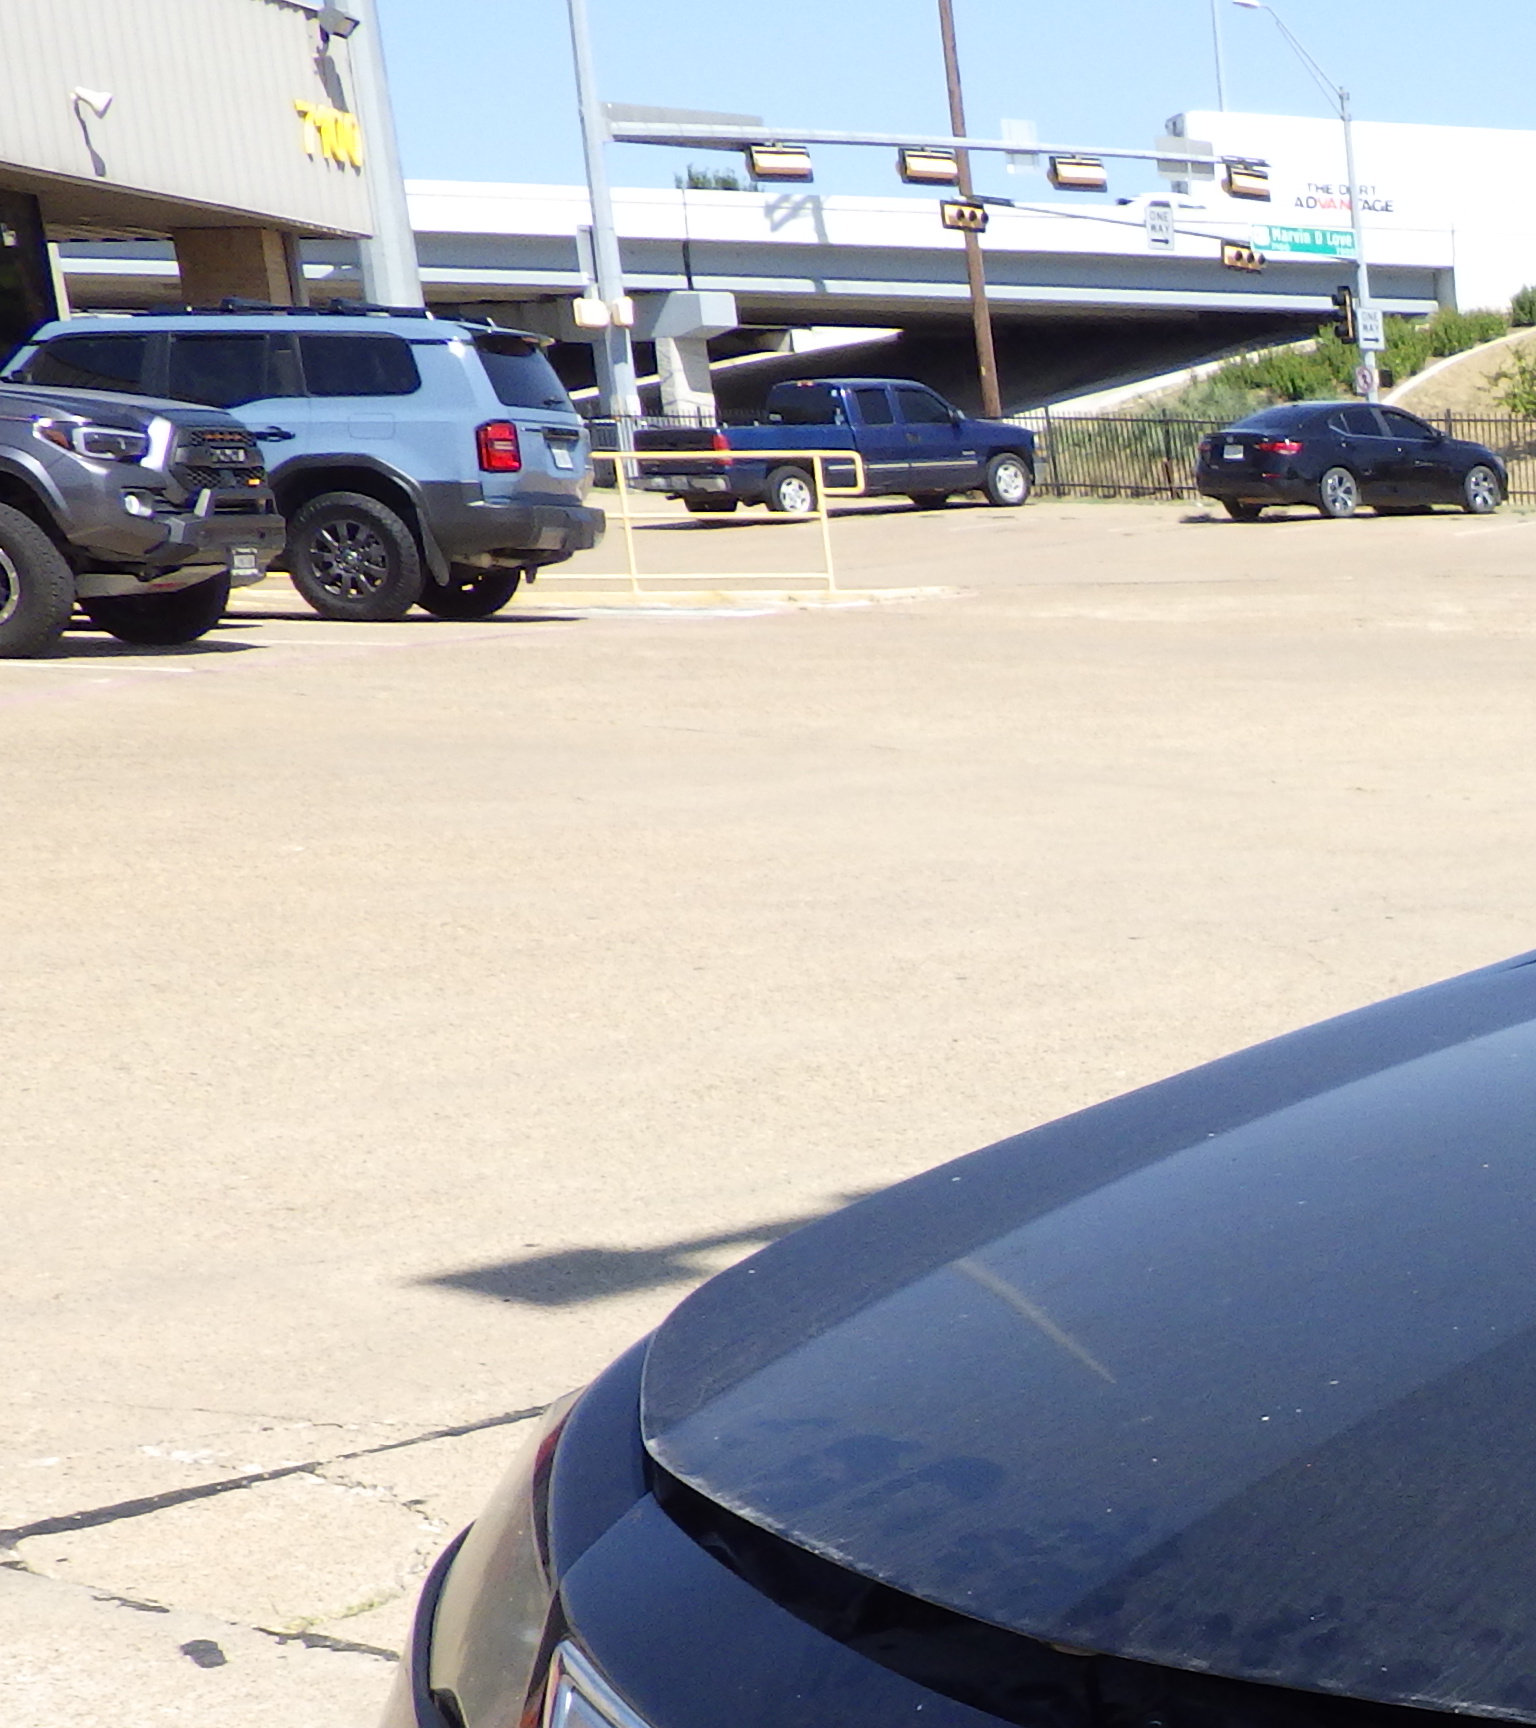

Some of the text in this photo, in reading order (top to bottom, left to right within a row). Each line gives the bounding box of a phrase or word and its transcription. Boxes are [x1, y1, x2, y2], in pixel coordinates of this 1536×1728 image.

[1307, 183, 1334, 195] THE
[1149, 210, 1170, 222] ONE
[1150, 224, 1170, 234] WAY
[1271, 227, 1353, 248] Marvin D Love
[1361, 311, 1379, 322] ONE
[1362, 323, 1380, 332] WAY
